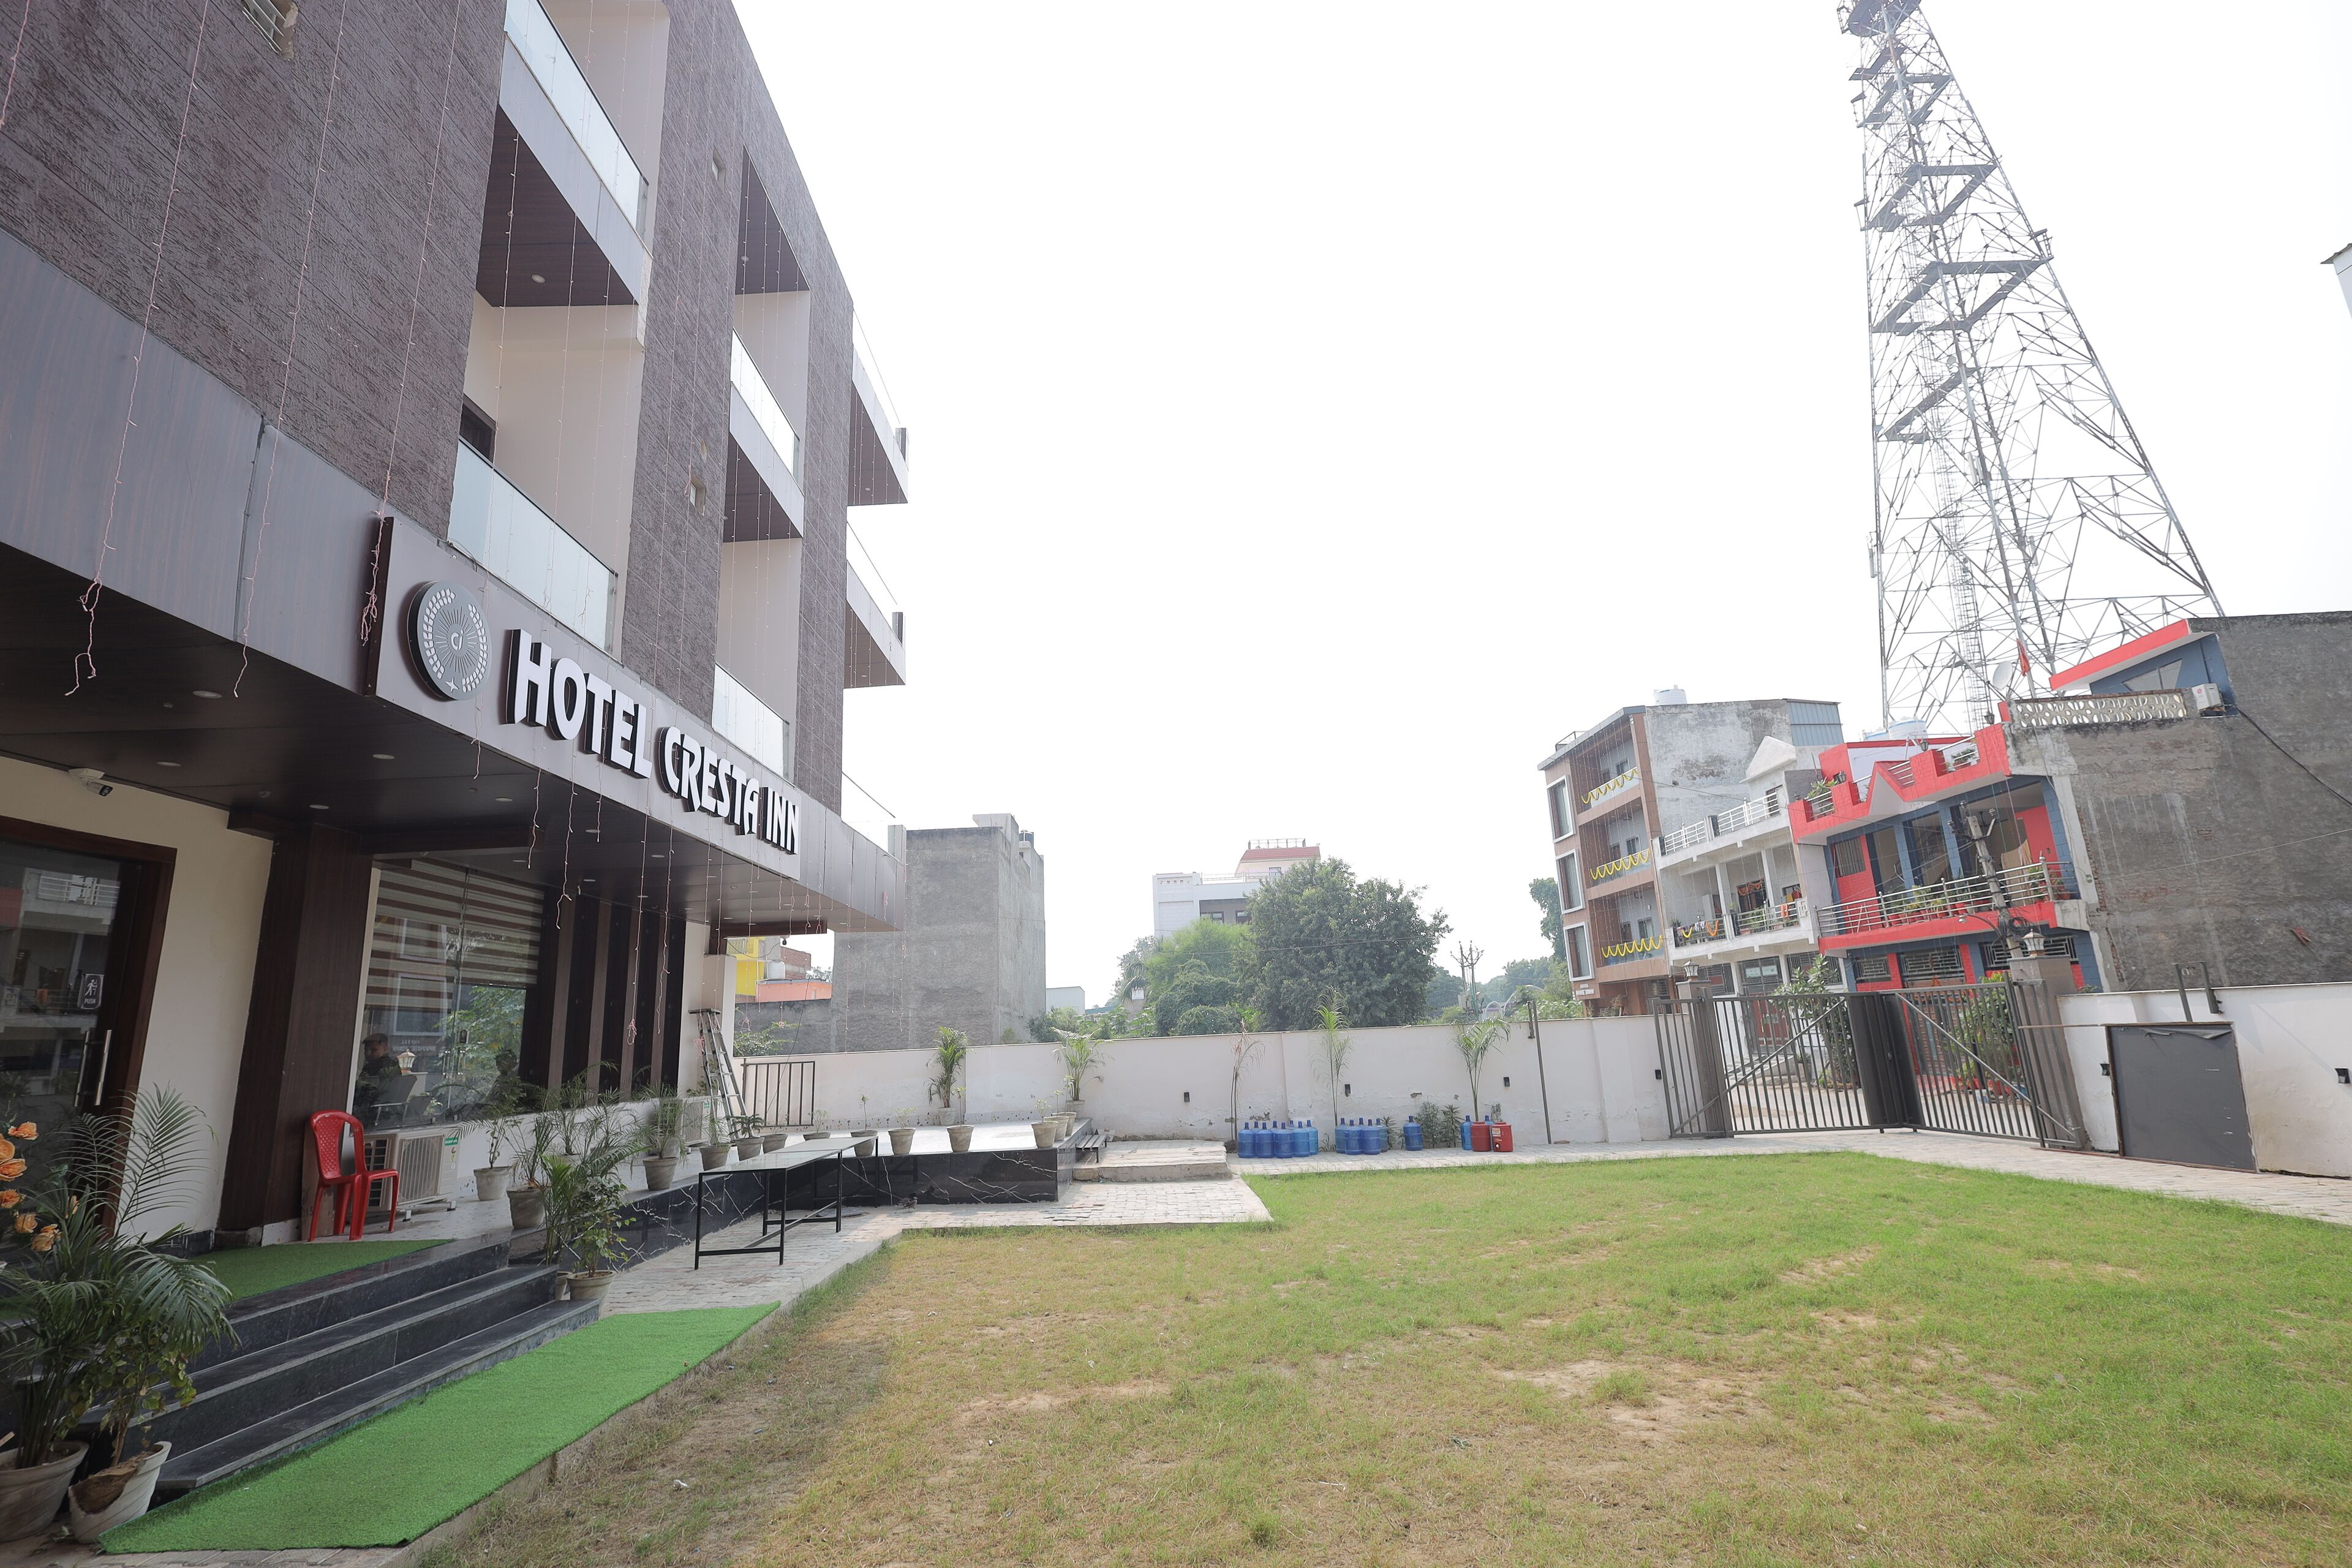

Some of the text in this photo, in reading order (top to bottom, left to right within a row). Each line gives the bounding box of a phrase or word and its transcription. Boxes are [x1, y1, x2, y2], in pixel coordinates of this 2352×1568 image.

[508, 629, 799, 854] HOTEL CRESTA INN
